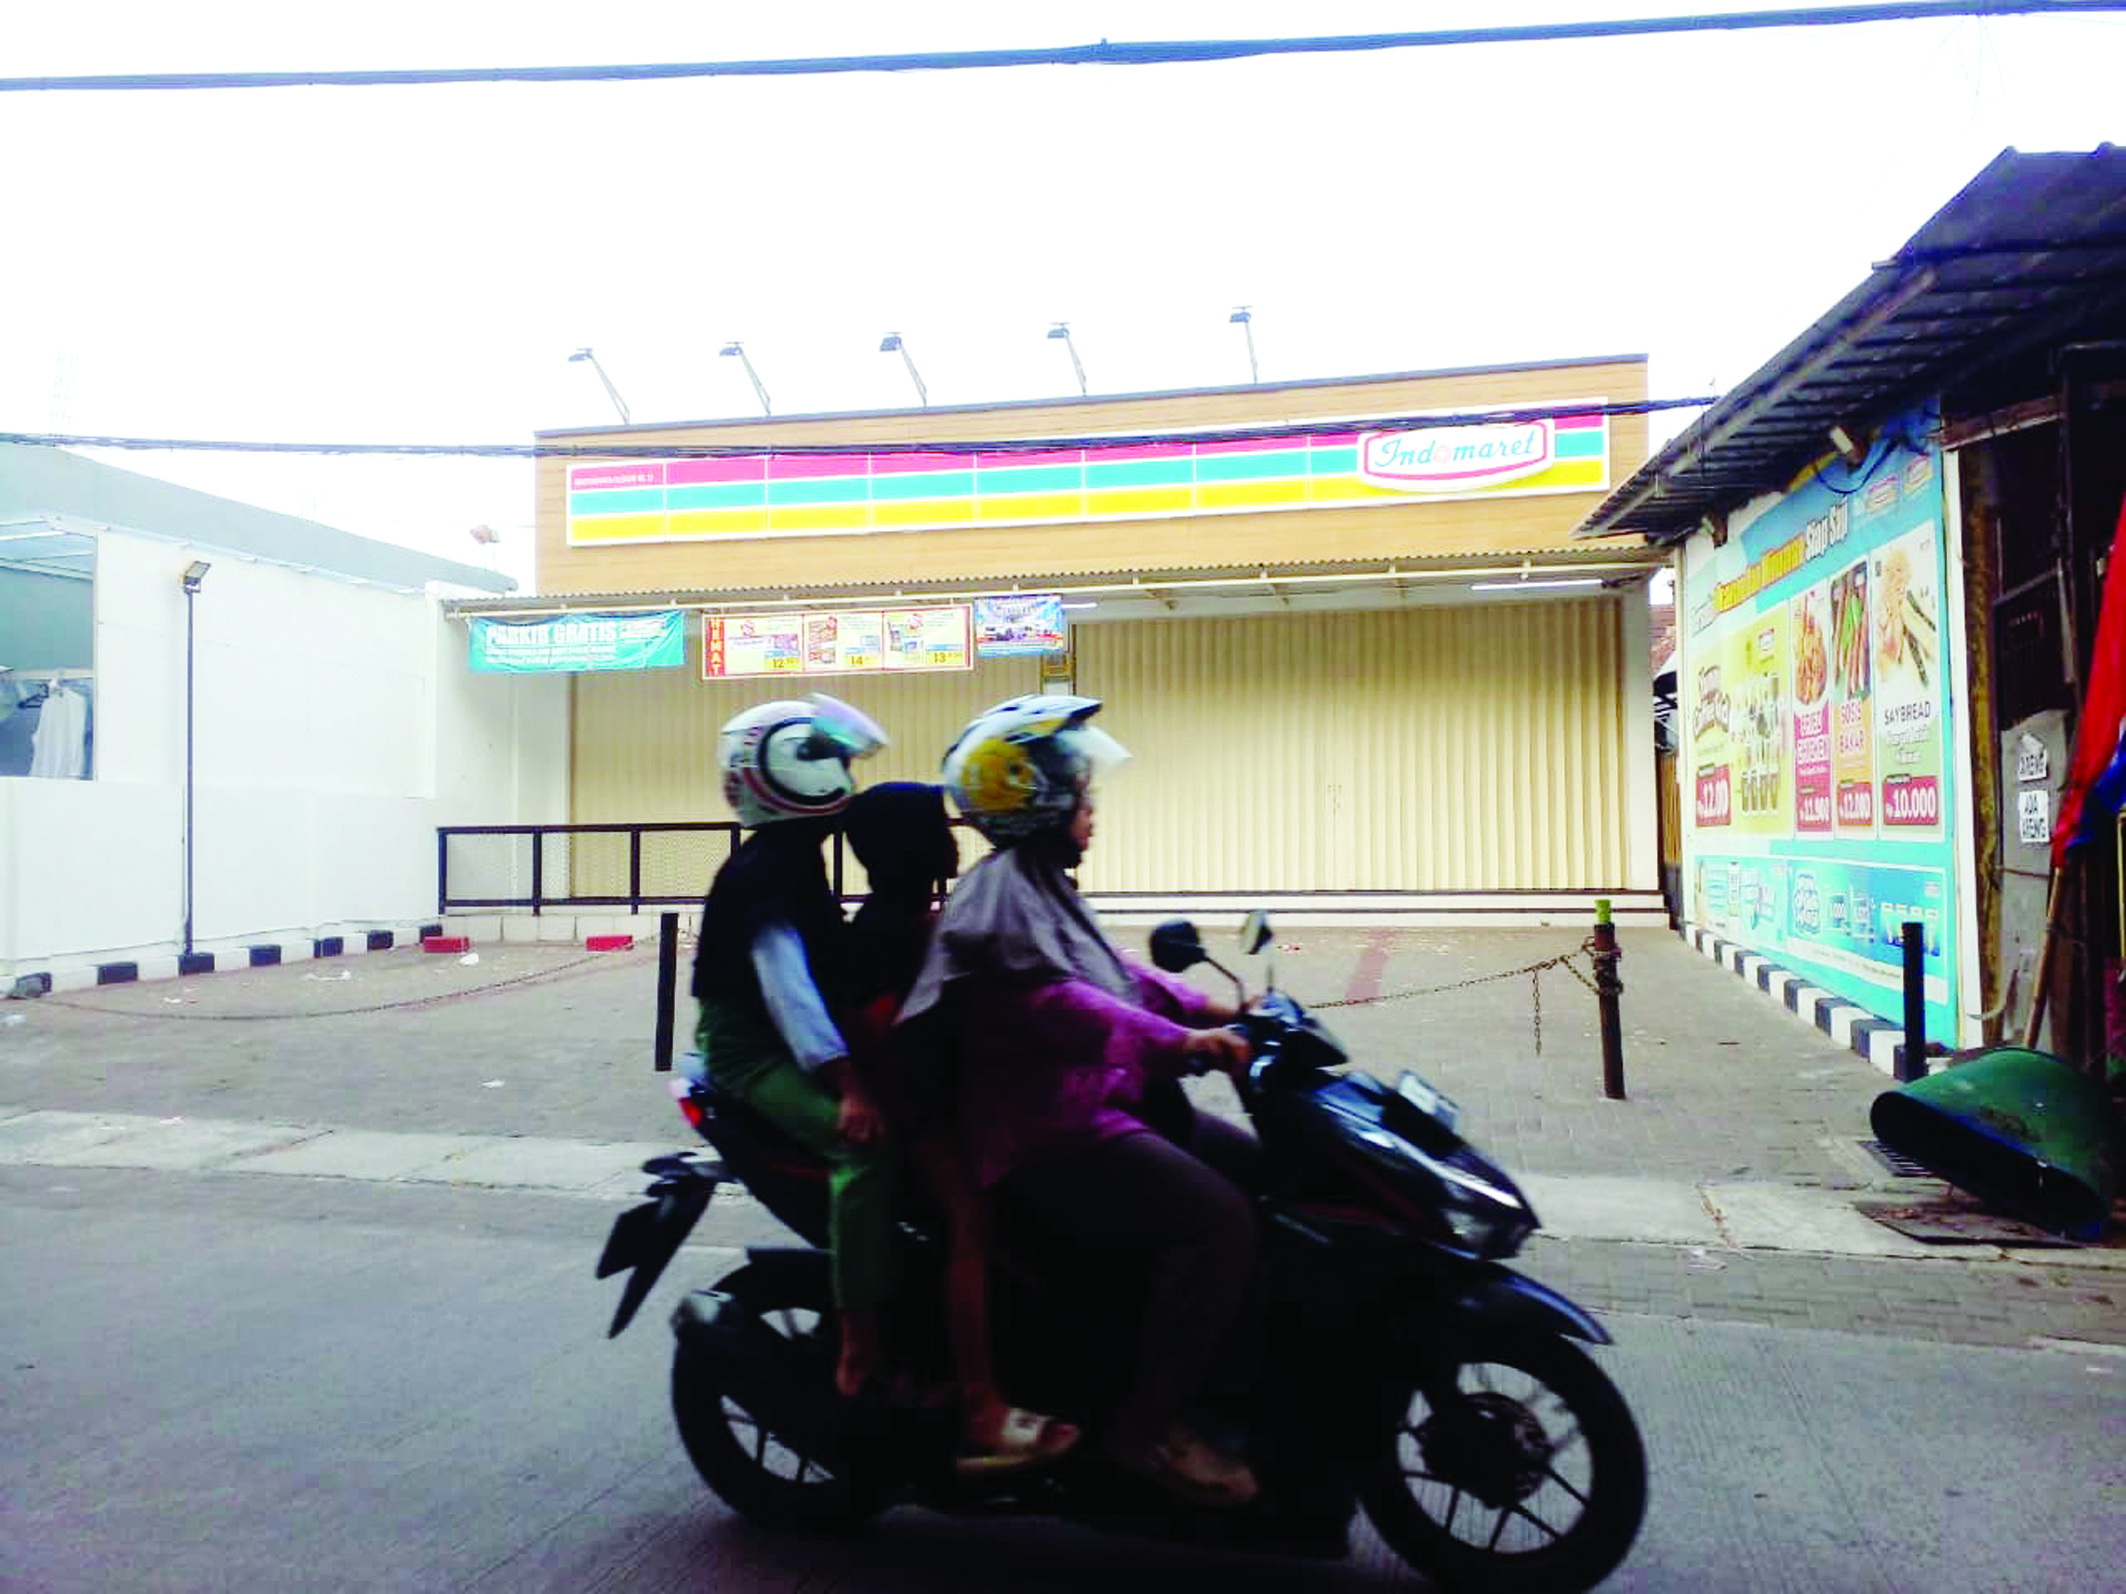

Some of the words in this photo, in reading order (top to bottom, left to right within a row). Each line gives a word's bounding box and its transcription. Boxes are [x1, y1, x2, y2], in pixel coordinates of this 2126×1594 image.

[1374, 430, 1536, 467] Indomaret
[486, 624, 549, 645] PARKIR
[554, 621, 618, 644] GRATIS
[1884, 700, 1932, 725] SAYBREAD
